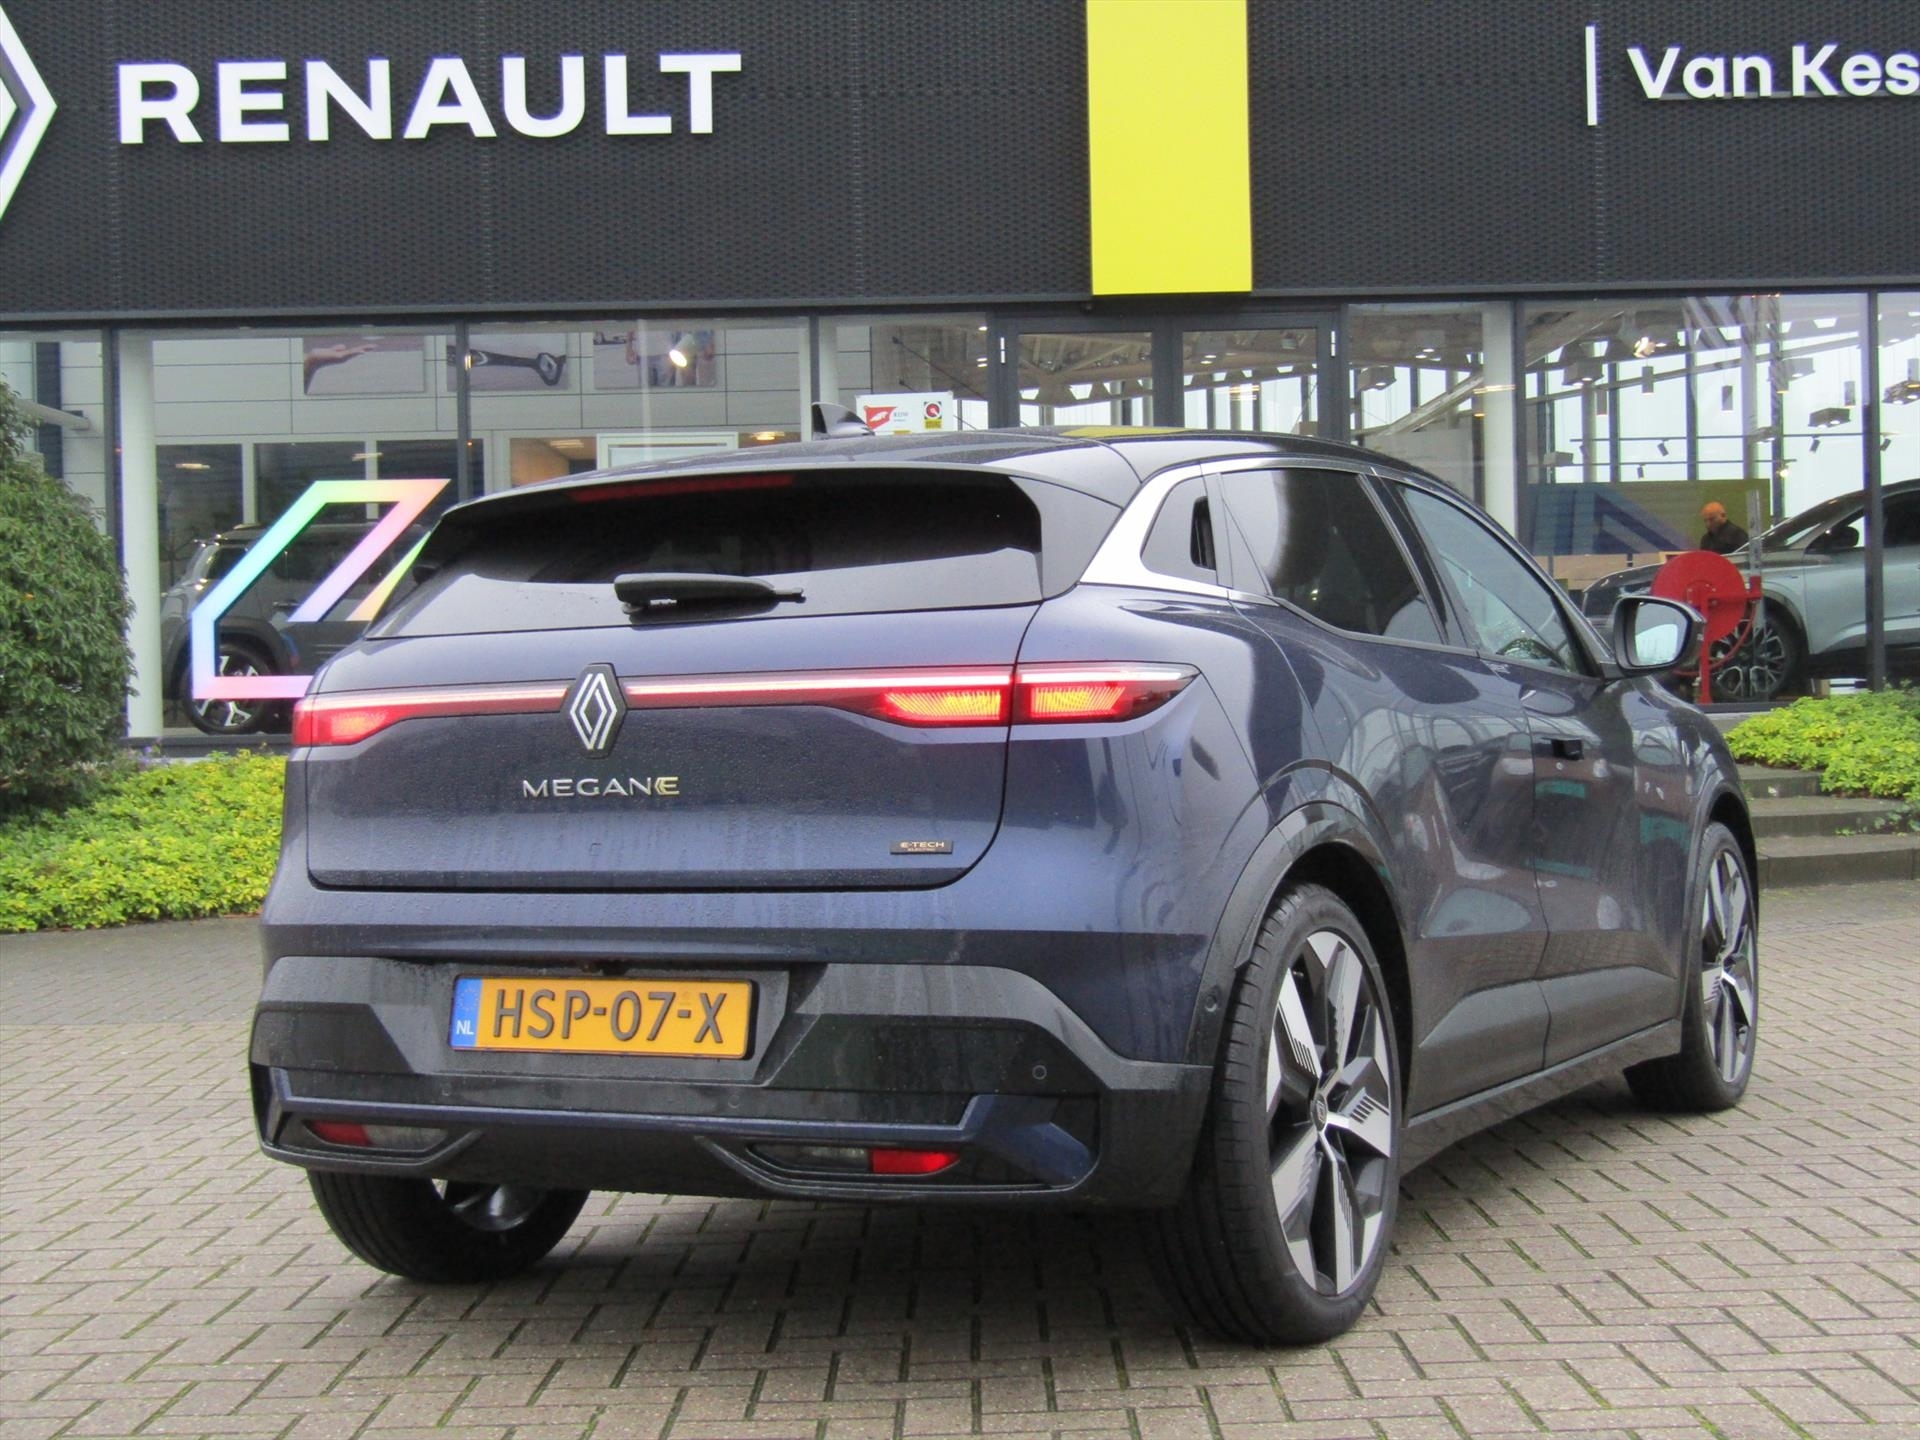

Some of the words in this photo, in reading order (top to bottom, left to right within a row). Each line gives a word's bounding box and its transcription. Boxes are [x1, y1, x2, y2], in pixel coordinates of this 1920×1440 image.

[117, 53, 742, 144] RENAULT
[1626, 47, 1772, 99] Van
[1792, 44, 1920, 96] Kes
[521, 774, 681, 799] MEGANE
[455, 1018, 475, 1036] NL
[492, 988, 728, 1044] HSP-07-X
